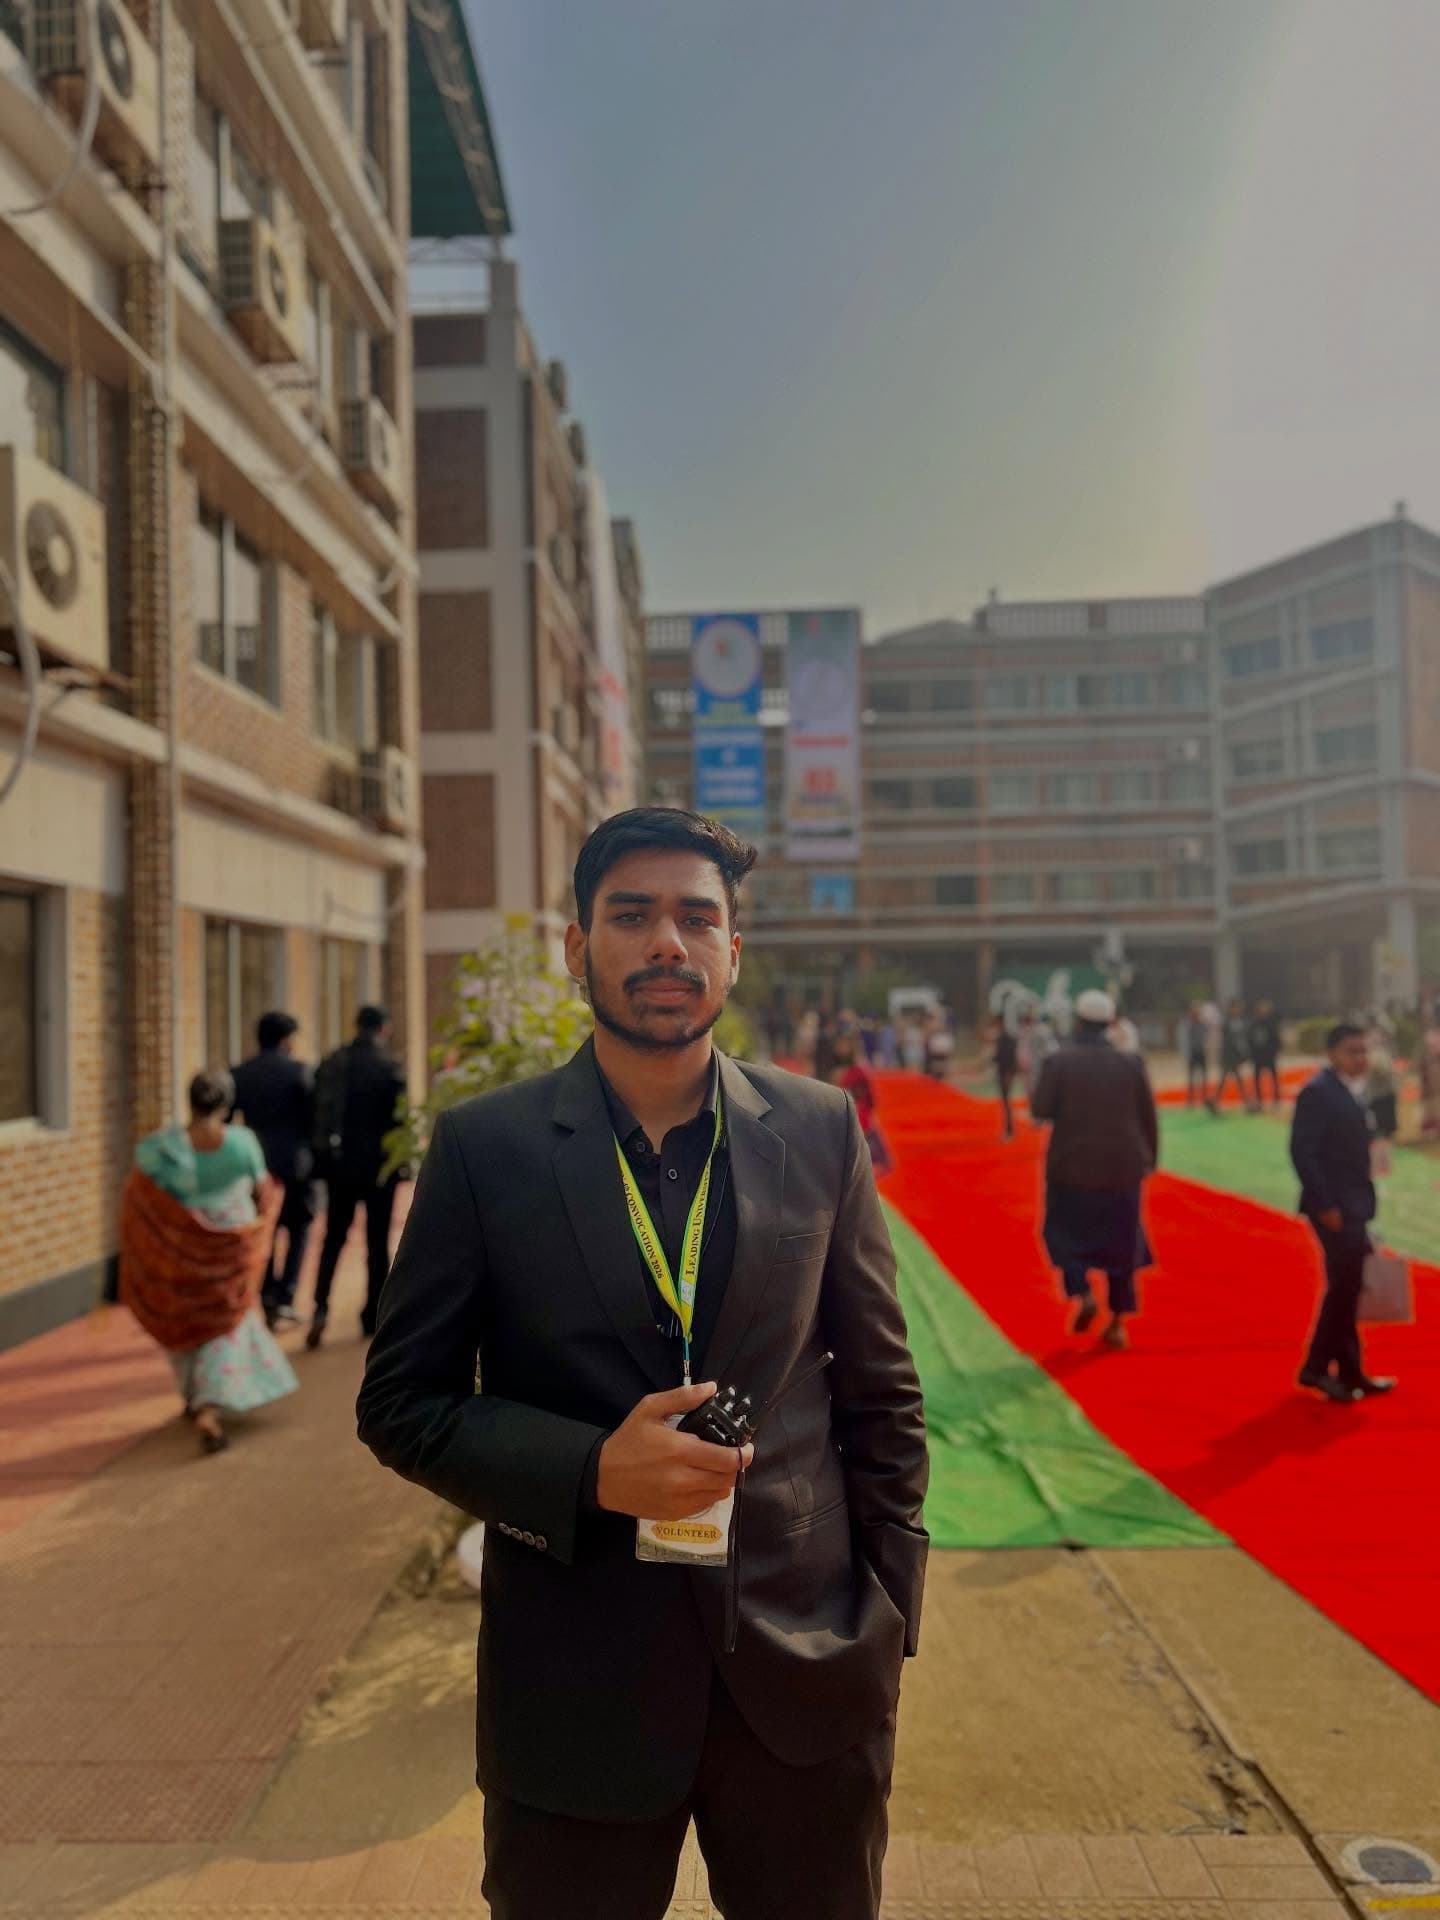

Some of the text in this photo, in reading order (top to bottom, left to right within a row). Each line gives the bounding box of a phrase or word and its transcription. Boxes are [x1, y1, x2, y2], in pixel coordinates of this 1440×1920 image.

[626, 1193, 656, 1259] CONVOCATION
[686, 1229, 699, 1275] LEADING
[656, 1526, 717, 1538] VOLUNTEER
